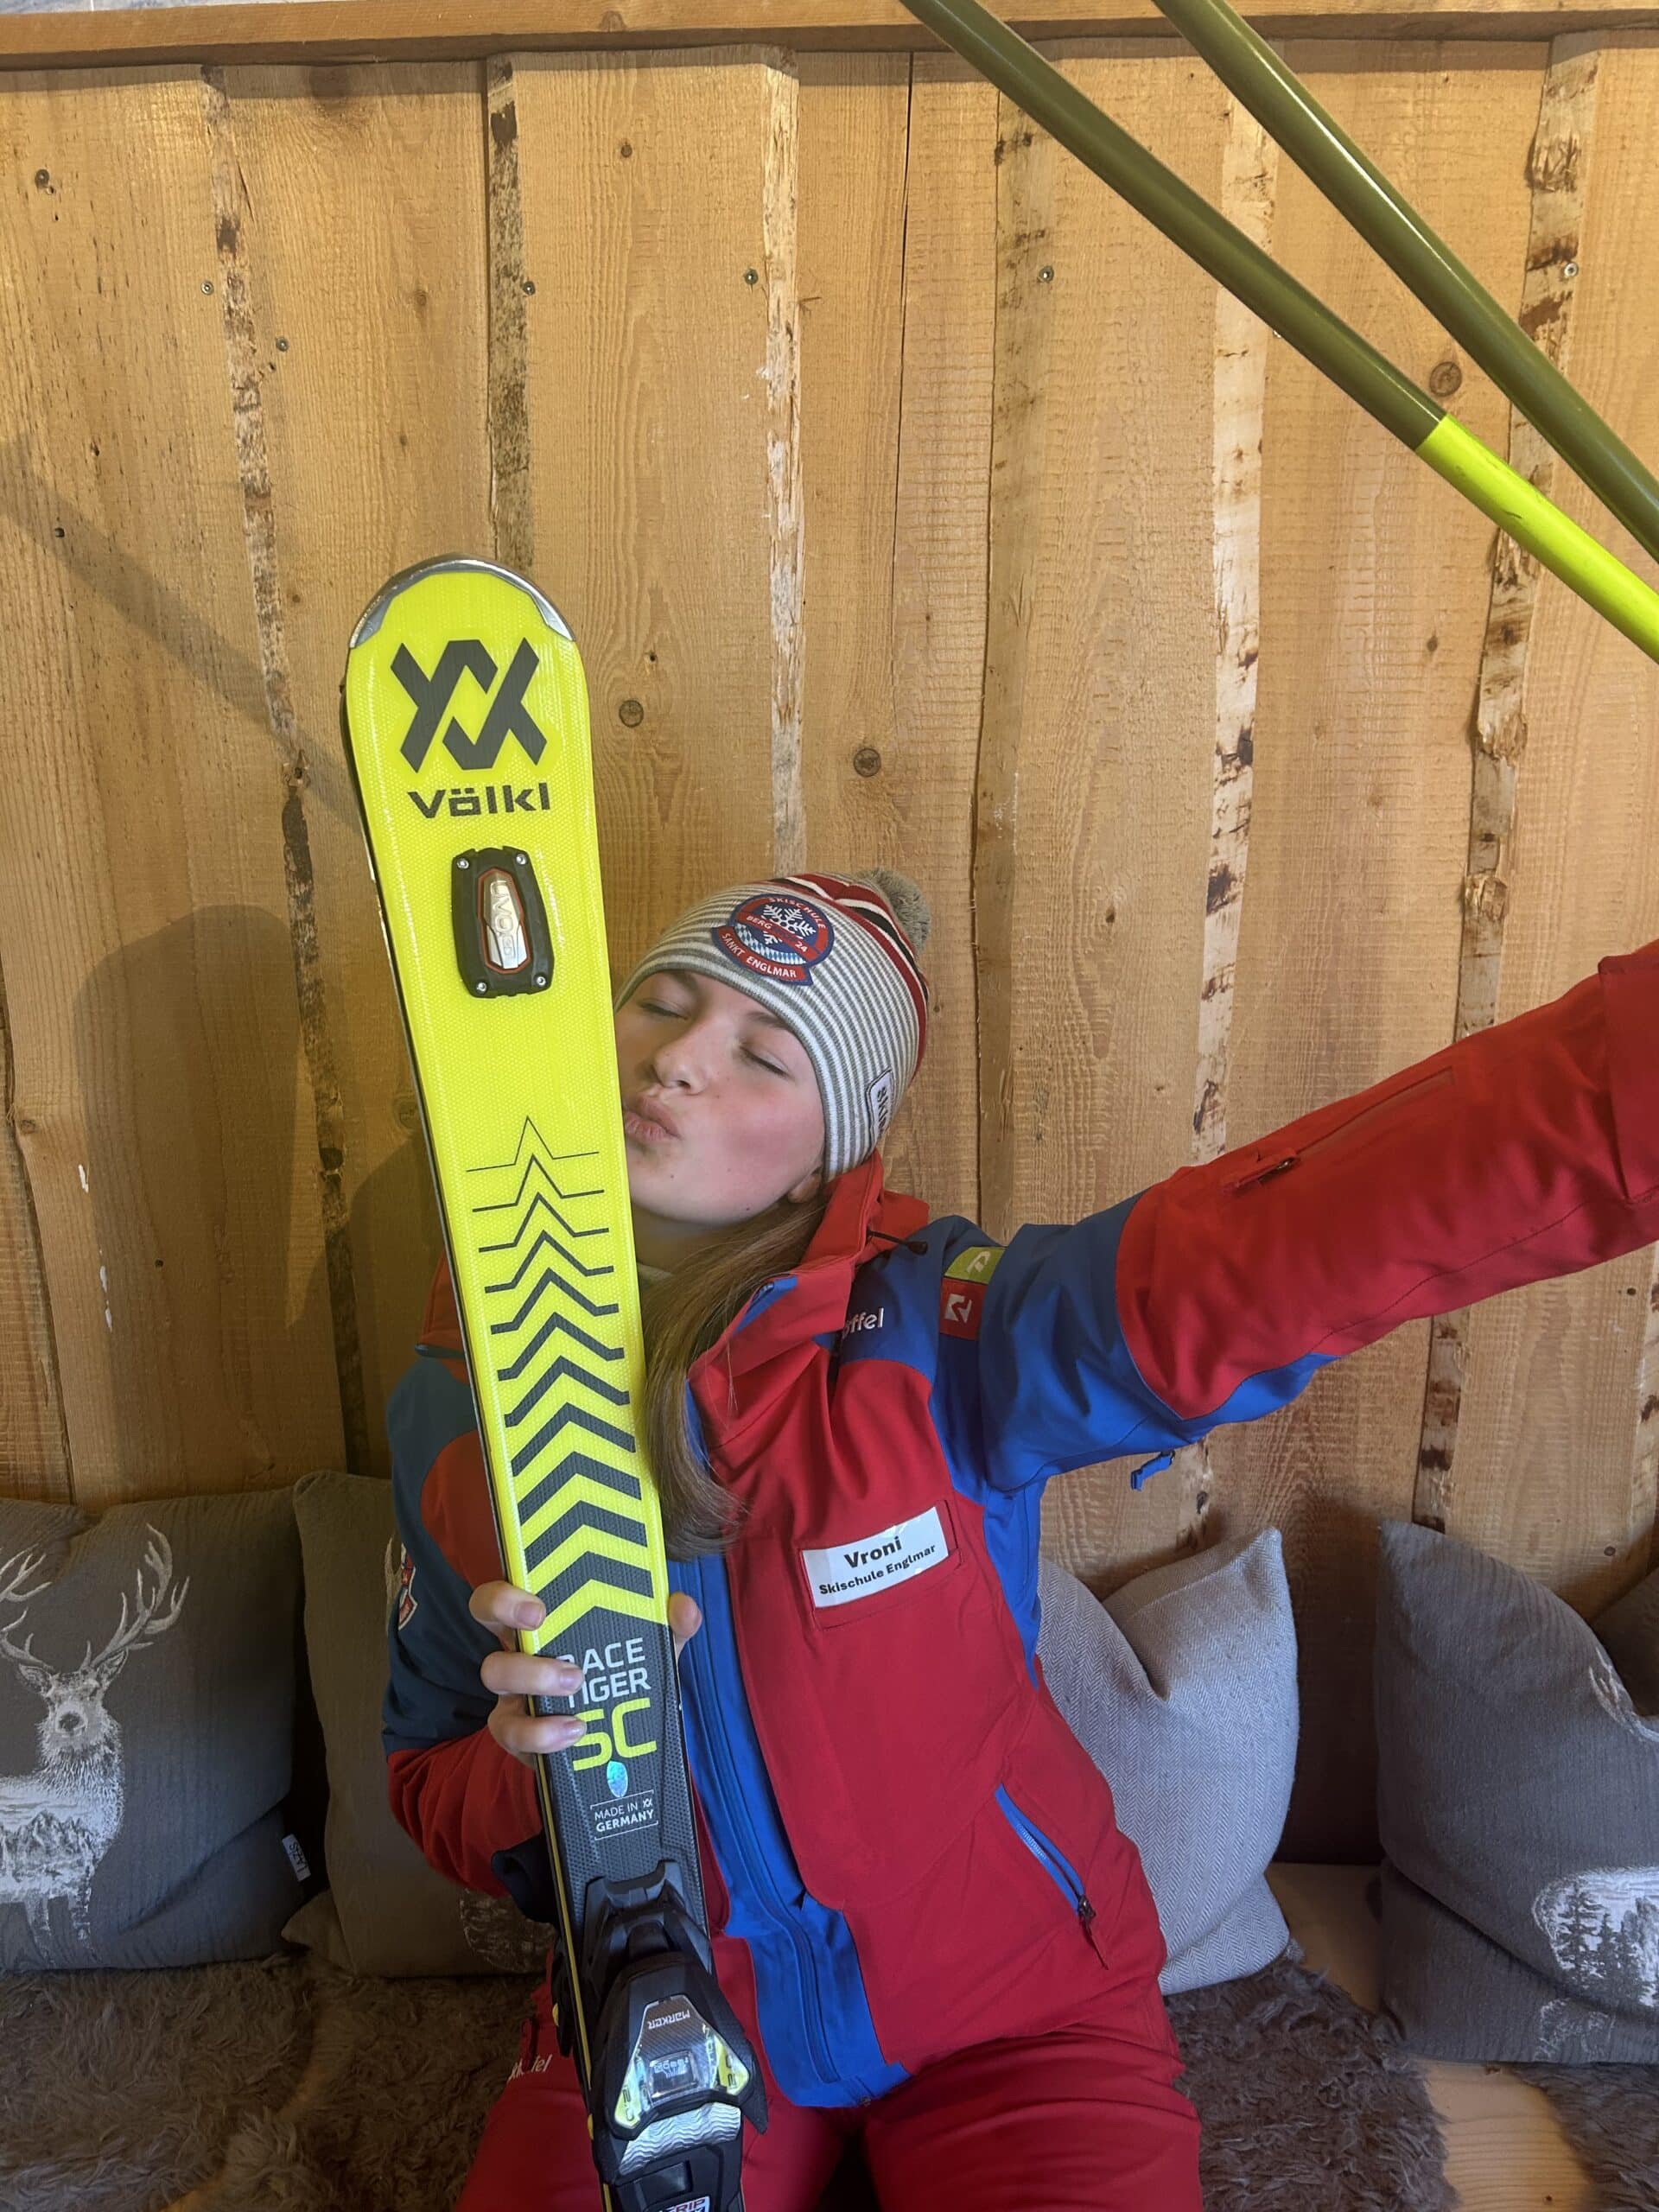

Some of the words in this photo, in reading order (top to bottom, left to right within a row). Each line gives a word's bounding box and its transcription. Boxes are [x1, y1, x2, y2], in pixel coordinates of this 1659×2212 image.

[408, 783, 550, 818] Völkl
[768, 897, 827, 929] SKISCHULE
[746, 915, 773, 930] BERG
[795, 942, 808, 952] 24
[721, 932, 746, 957] SANKT
[746, 955, 797, 978] ENGLMAR
[843, 1535, 902, 1569] Vroni
[819, 1569, 884, 1595] Skischule
[886, 1545, 936, 1575] Englmar
[573, 1697, 657, 1771] SC
[594, 1804, 625, 1821] MADE
[627, 1802, 638, 1813] IN
[596, 1809, 654, 1832] GERMANY
[647, 2010, 690, 2030] MARKER
